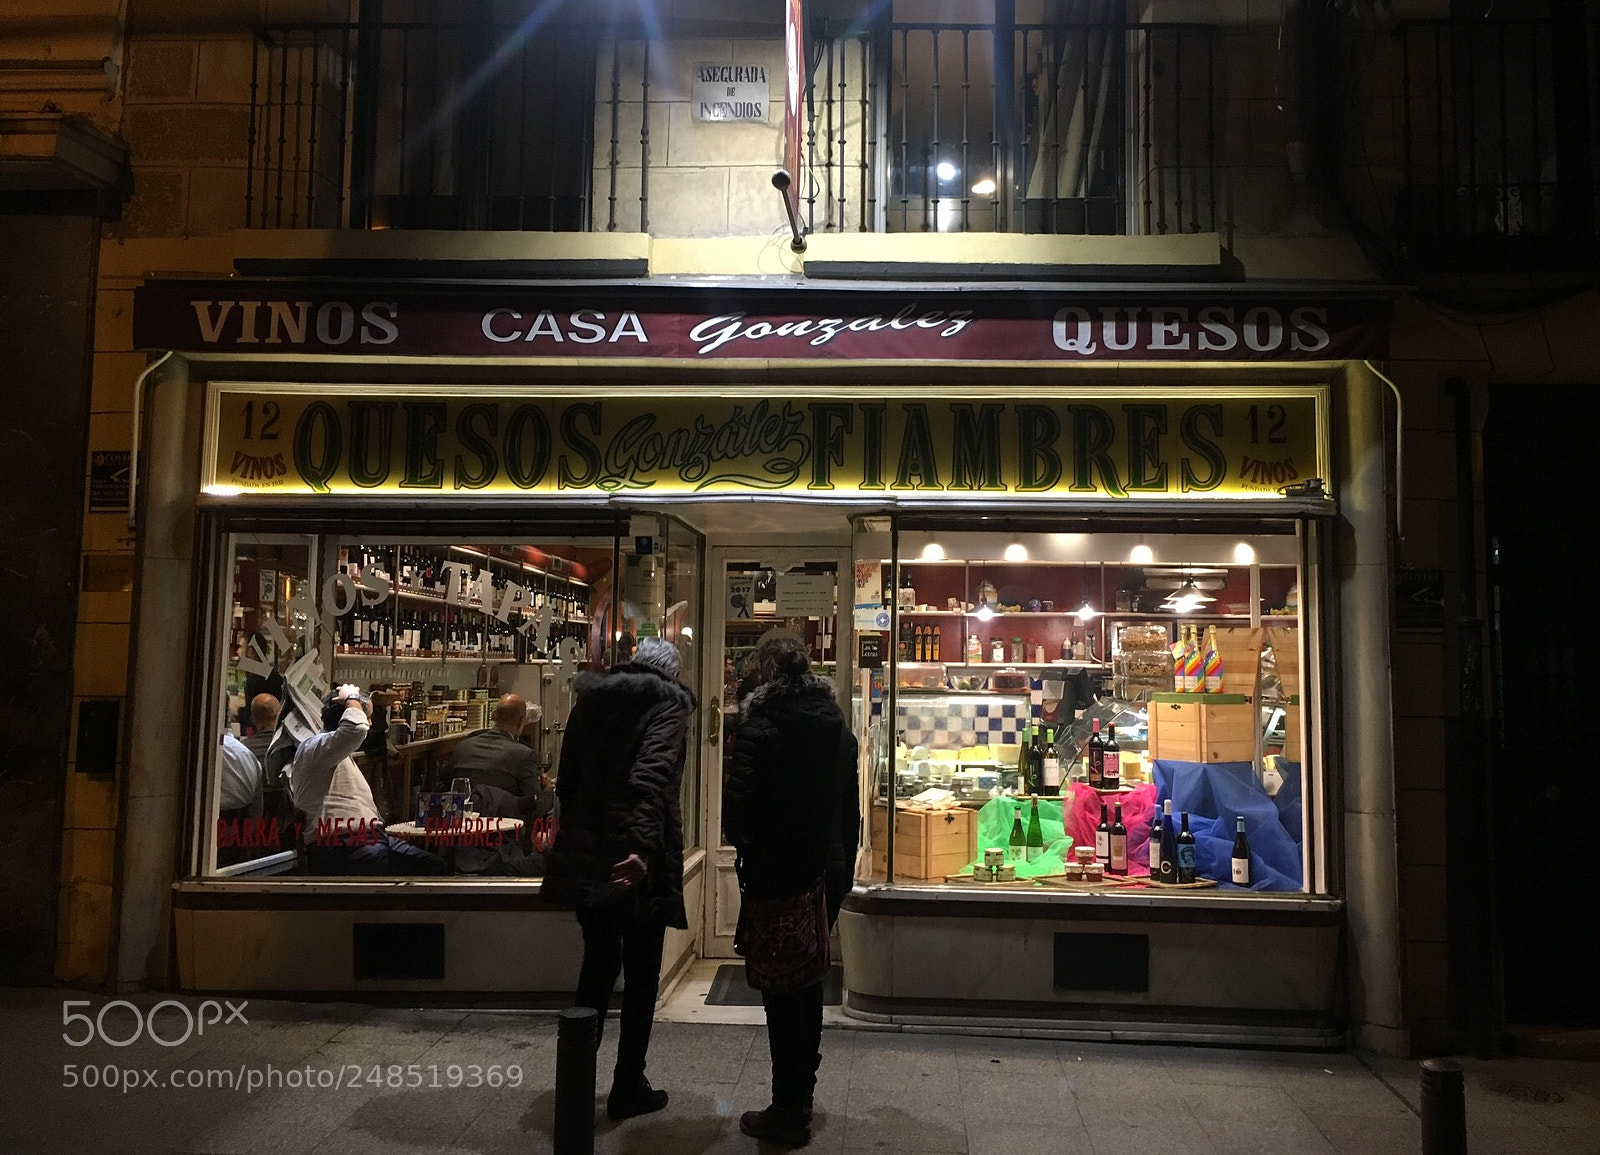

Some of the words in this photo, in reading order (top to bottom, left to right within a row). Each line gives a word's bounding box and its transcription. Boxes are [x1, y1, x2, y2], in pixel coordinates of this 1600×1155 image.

[697, 66, 766, 83] ASEGURADA
[726, 87, 736, 97] DE
[190, 300, 399, 345] VINOS
[481, 307, 649, 344] CASA
[689, 302, 974, 354] Gonzalez
[1052, 306, 1329, 354] QUESOS
[241, 400, 281, 441] 12
[1247, 404, 1288, 444] 12
[293, 400, 602, 494] QUESOS
[595, 399, 811, 493] González
[807, 402, 1226, 498] FIAMBRES
[230, 450, 287, 480] VINOS
[1239, 455, 1298, 485] VINOS
[236, 562, 389, 680] VINOS
[408, 570, 426, 591] Y
[440, 560, 587, 680] TAPAS
[217, 817, 280, 847] BARRA
[316, 817, 378, 847] MESAS
[424, 816, 503, 848] FIAMBRES
[514, 823, 521, 841] Y
[1160, 860, 1174, 875] C
